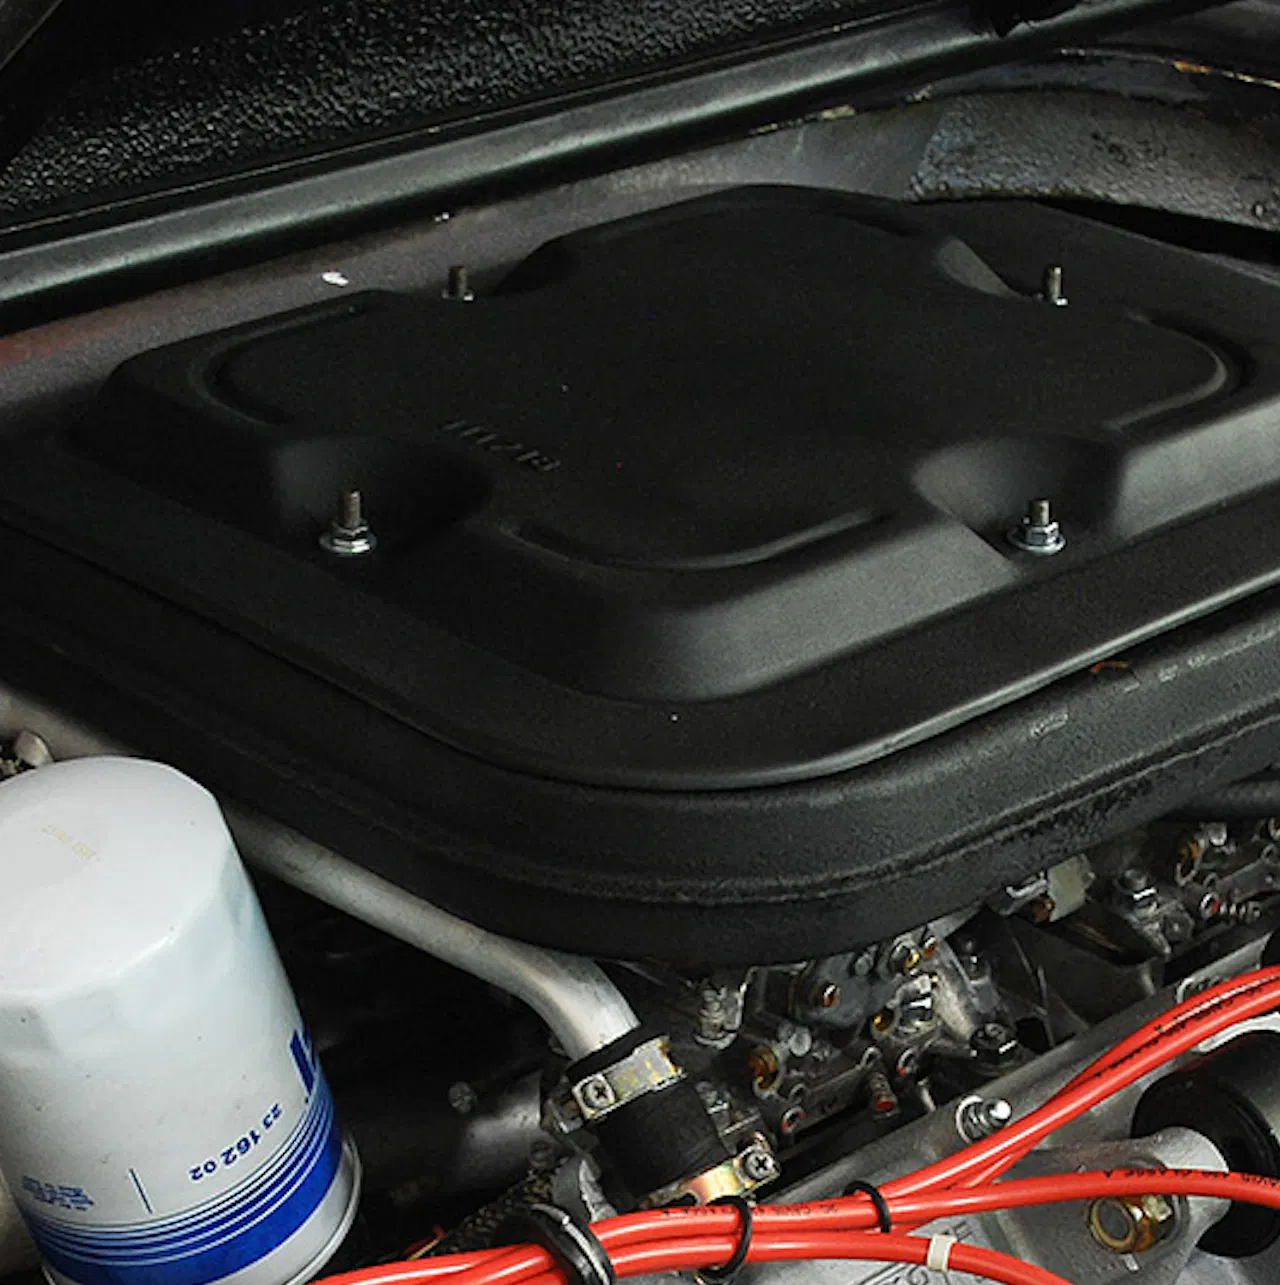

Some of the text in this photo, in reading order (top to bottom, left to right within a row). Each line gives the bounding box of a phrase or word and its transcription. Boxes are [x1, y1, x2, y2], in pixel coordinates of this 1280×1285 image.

[187, 1103, 284, 1182] 23 162 02
